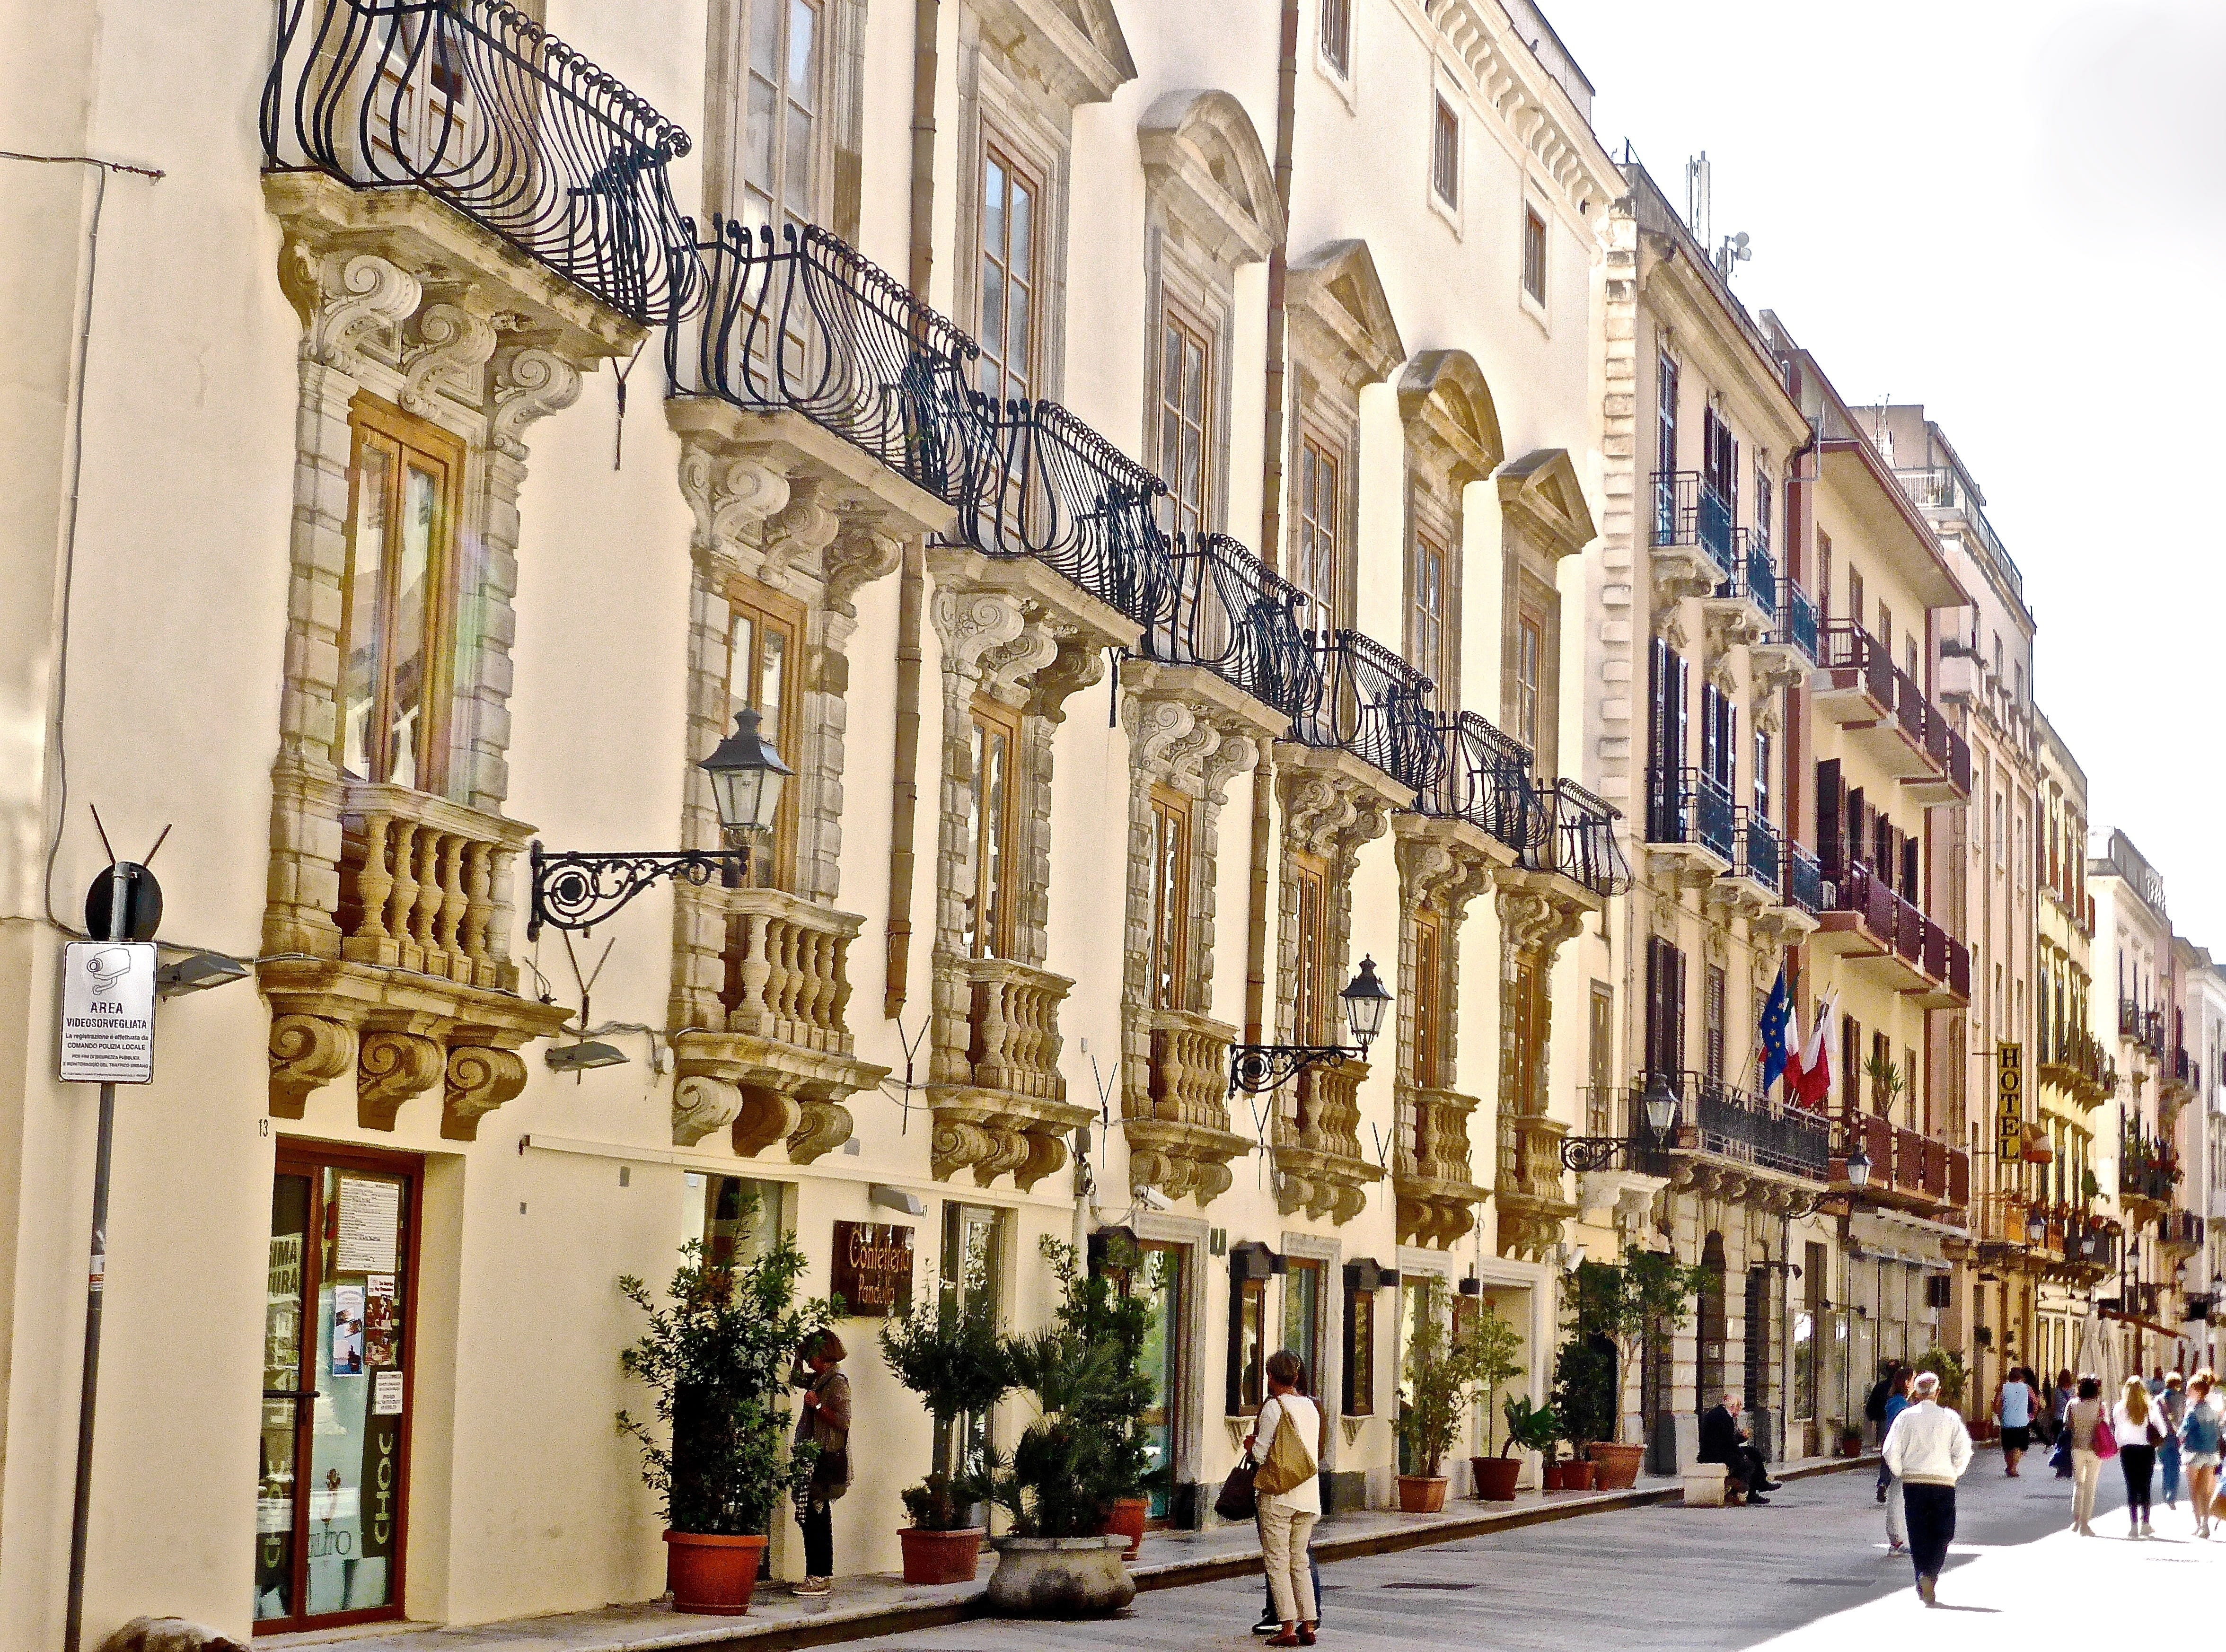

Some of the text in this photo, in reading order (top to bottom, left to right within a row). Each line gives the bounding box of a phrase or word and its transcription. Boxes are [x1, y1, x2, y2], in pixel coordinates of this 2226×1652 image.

[90, 1002, 123, 1014] AREA
[66, 1018, 147, 1028] VIDEOSORVEGLIATA
[2000, 1048, 2019, 1159] HOTEL
[259, 1119, 268, 1137] 13
